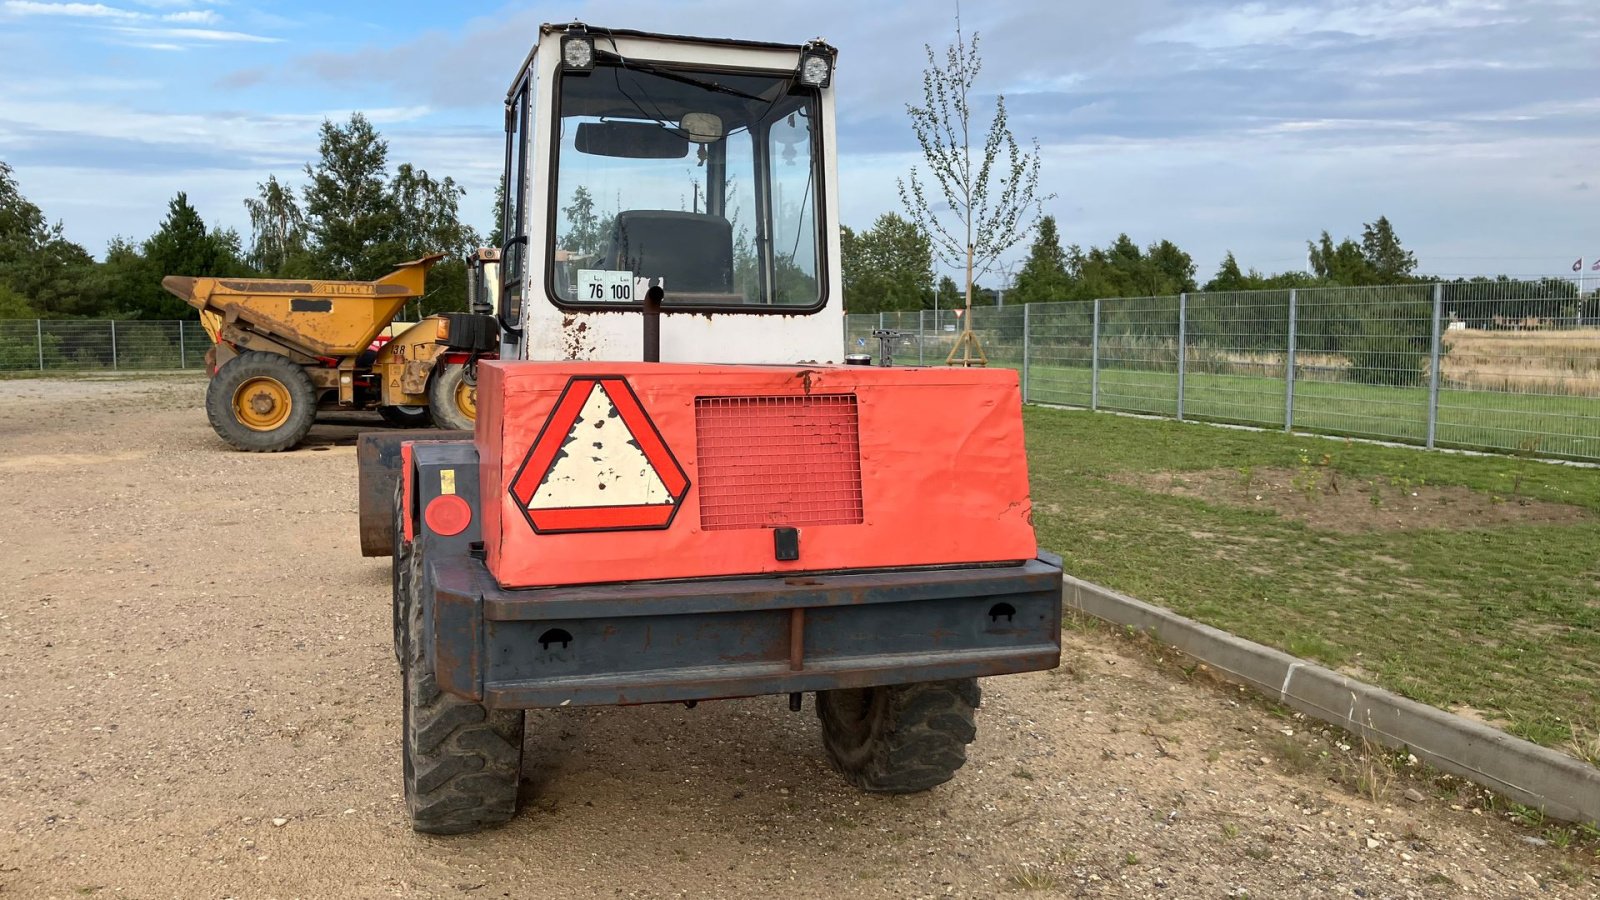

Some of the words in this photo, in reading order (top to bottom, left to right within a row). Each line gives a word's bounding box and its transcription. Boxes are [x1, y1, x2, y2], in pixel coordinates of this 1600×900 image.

[589, 283, 603, 299] 76
[611, 284, 630, 299] 100
[391, 344, 406, 355] 138
